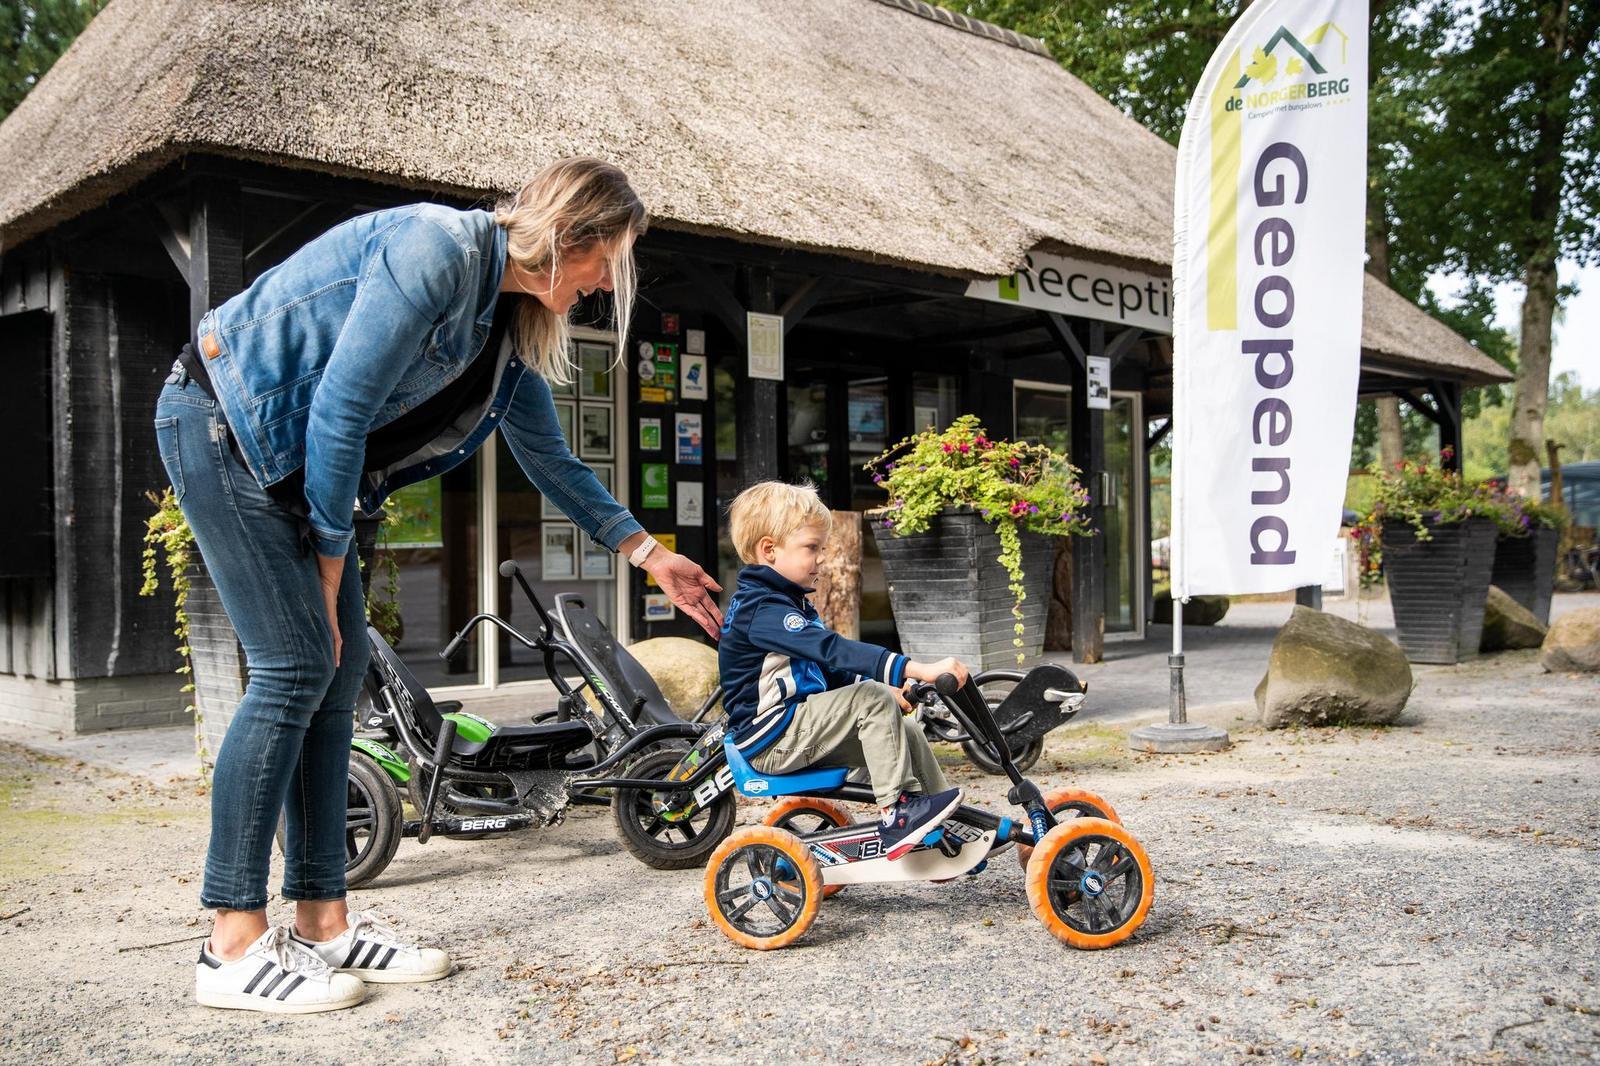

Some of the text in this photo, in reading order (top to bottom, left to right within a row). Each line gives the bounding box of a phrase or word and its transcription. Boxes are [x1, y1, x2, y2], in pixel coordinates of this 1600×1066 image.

[1225, 78, 1350, 112] de NORGERBERG
[1288, 101, 1322, 112] bungalows
[1010, 254, 1174, 319] Recepti
[1241, 141, 1308, 566] Geopend
[693, 764, 735, 808] BE
[461, 818, 507, 831] BERG
